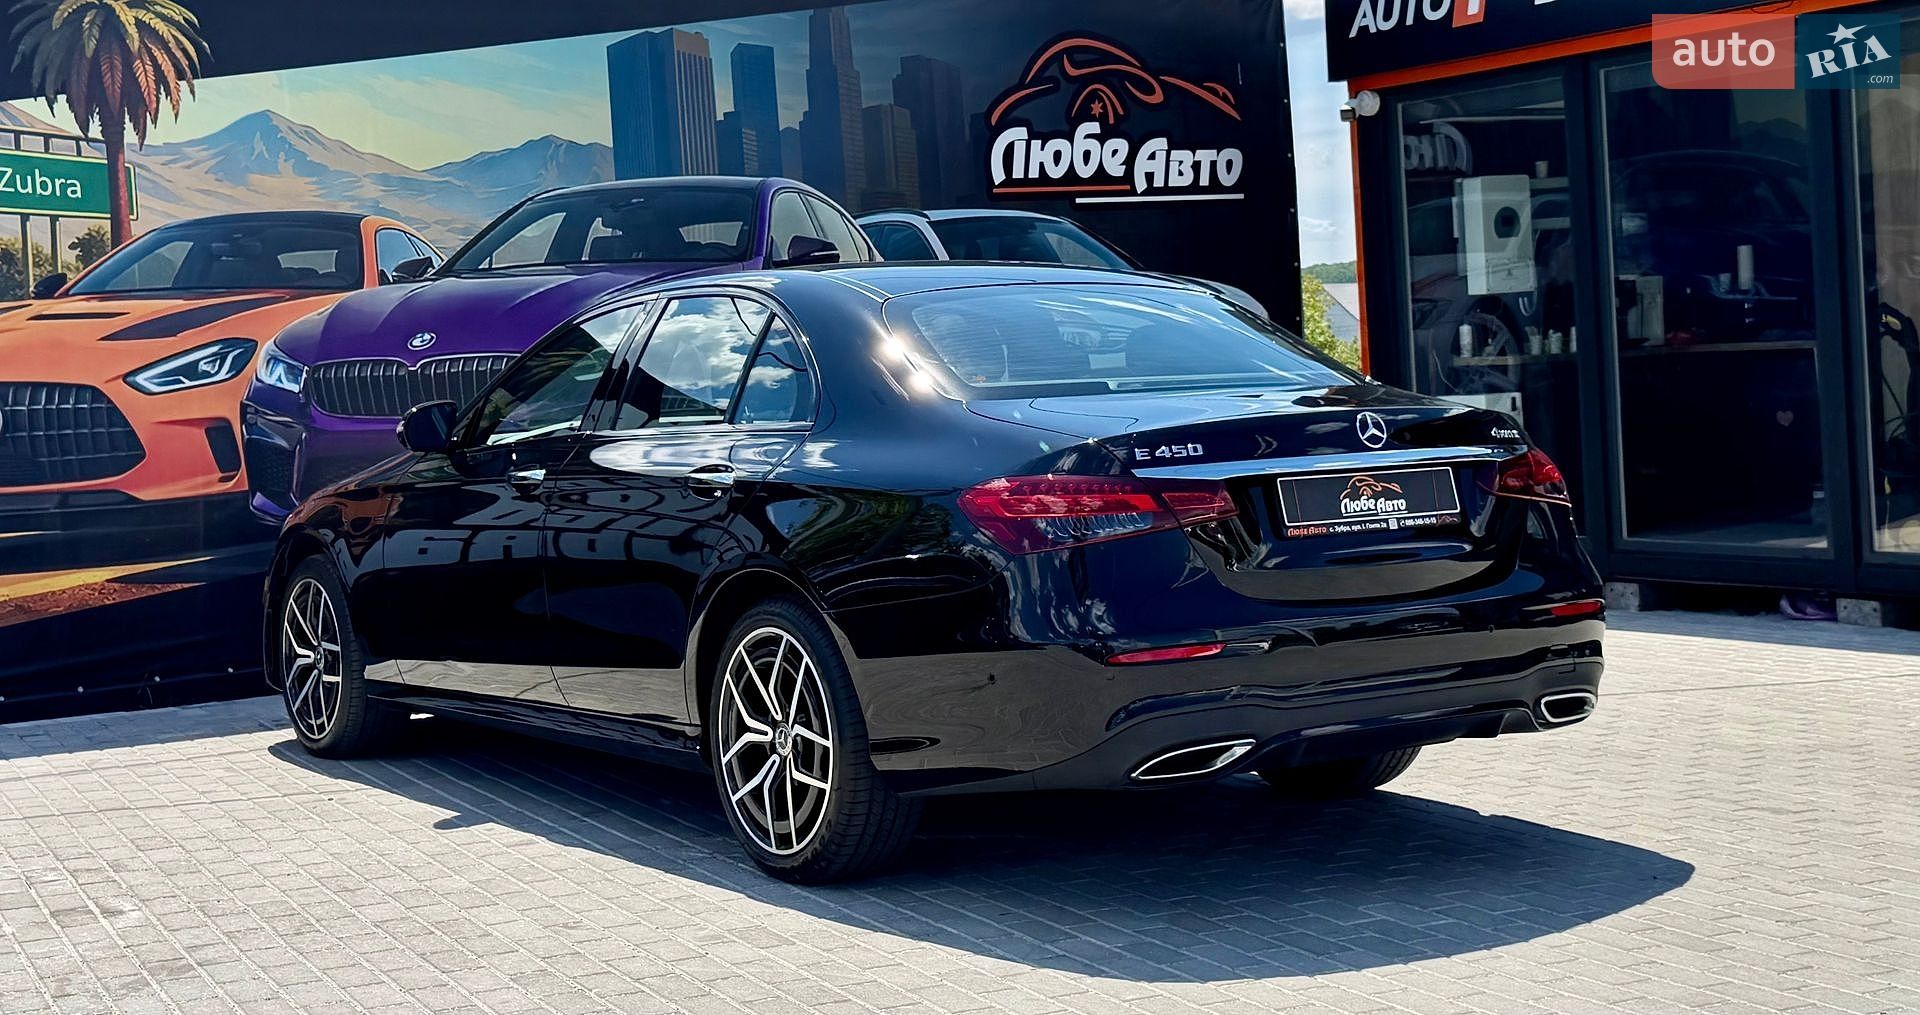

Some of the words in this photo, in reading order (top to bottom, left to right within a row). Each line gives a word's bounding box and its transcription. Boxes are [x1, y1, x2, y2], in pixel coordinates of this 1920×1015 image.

[991, 122, 1130, 185] Любе
[0, 167, 82, 198] Zubra
[1135, 447, 1151, 460] E
[1155, 443, 1203, 457] 450
[1341, 496, 1375, 514] Любе
